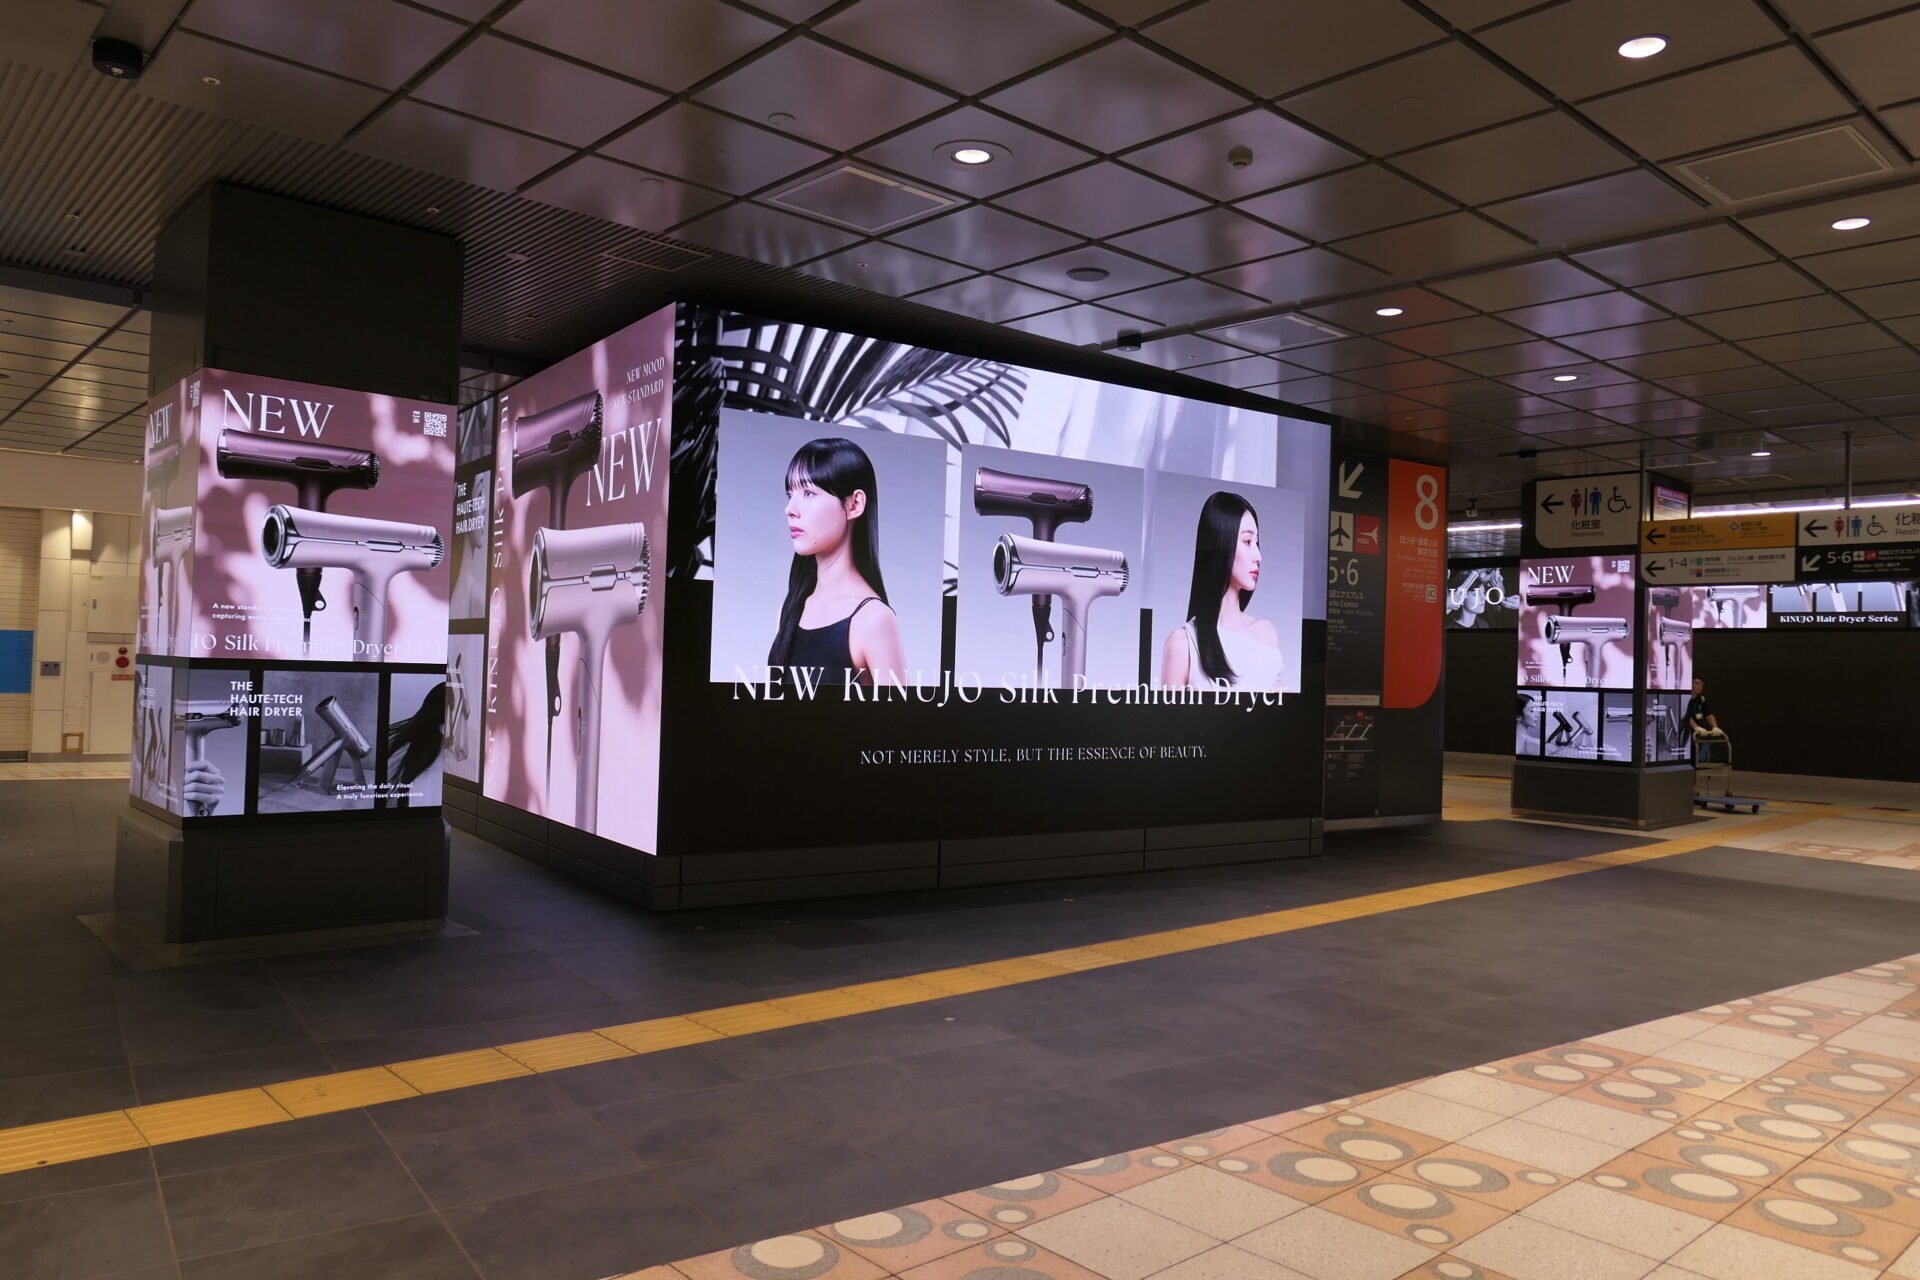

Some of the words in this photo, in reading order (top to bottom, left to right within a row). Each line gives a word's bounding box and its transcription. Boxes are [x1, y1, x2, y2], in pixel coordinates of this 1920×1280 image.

[643, 356, 665, 377] MOOD
[628, 378, 664, 404] STANDARD
[150, 402, 173, 444] NEW
[222, 389, 334, 439] NEW
[586, 417, 663, 506] NEW
[457, 482, 467, 498] THE
[456, 496, 486, 516] HAUTE-TECH
[1414, 474, 1439, 530] 8
[468, 515, 485, 532] DRYER
[494, 507, 505, 568] Silk
[1527, 565, 1575, 584] NEW
[212, 613, 246, 621] capturing
[1780, 615, 1814, 624] KINUJO
[1817, 615, 1837, 623] Hair
[1839, 615, 1866, 624] Dryer
[1868, 615, 1899, 623] Series
[225, 634, 259, 651] Silk
[353, 639, 401, 658] Dryer
[230, 681, 253, 691] THE
[732, 665, 825, 701] NEW
[843, 667, 983, 708] KINUJO
[1000, 670, 1059, 704] Silk
[1072, 673, 1203, 705] Premium
[1214, 677, 1288, 713] Dryer
[230, 694, 303, 704] HAUTE-TECH
[229, 706, 260, 717] HAIR
[264, 707, 303, 717] DRYER
[861, 750, 894, 765] NOT
[900, 749, 960, 764] MERELY
[964, 748, 1011, 763] STYLE,
[1016, 748, 1043, 762] BUT
[1047, 747, 1073, 761] THE
[1078, 746, 1135, 760] ESSENCE
[1139, 746, 1157, 760] OF
[1160, 745, 1207, 759] BEAUTY.
[343, 793, 358, 801] truly
